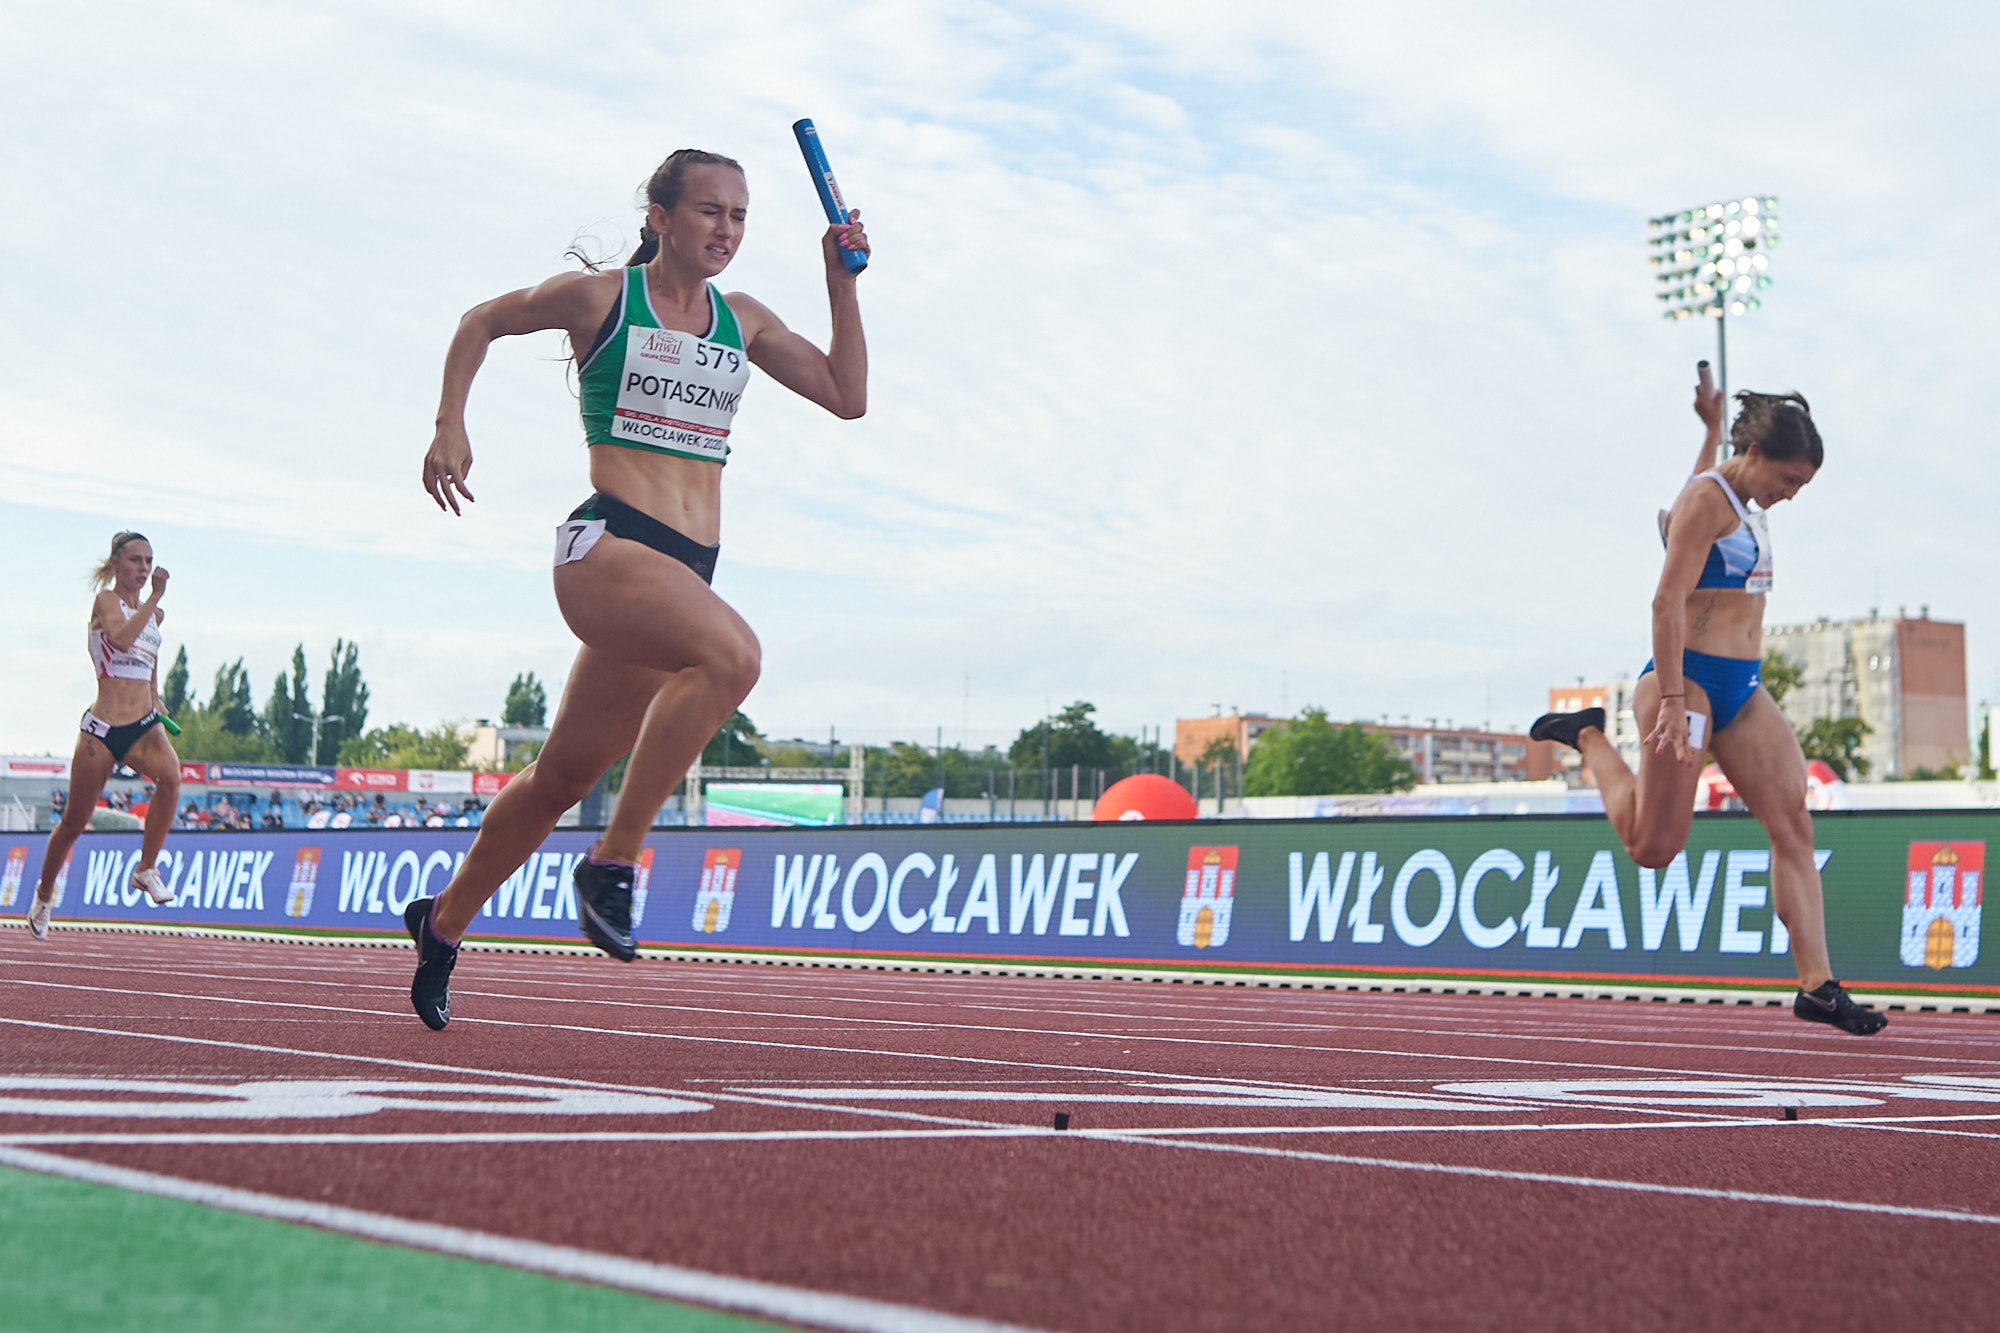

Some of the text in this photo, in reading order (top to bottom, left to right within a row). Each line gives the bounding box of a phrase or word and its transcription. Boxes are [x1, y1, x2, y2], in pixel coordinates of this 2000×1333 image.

[642, 333, 683, 355] Anwil
[695, 343, 740, 373] 579
[626, 372, 740, 413] POTASZNIK
[622, 420, 701, 447] WŁOCŁAWEK
[565, 525, 587, 559] 7
[86, 720, 99, 734] 5
[338, 850, 587, 920] WŁOCWEK
[771, 852, 1140, 937] WŁOCŁAWEK
